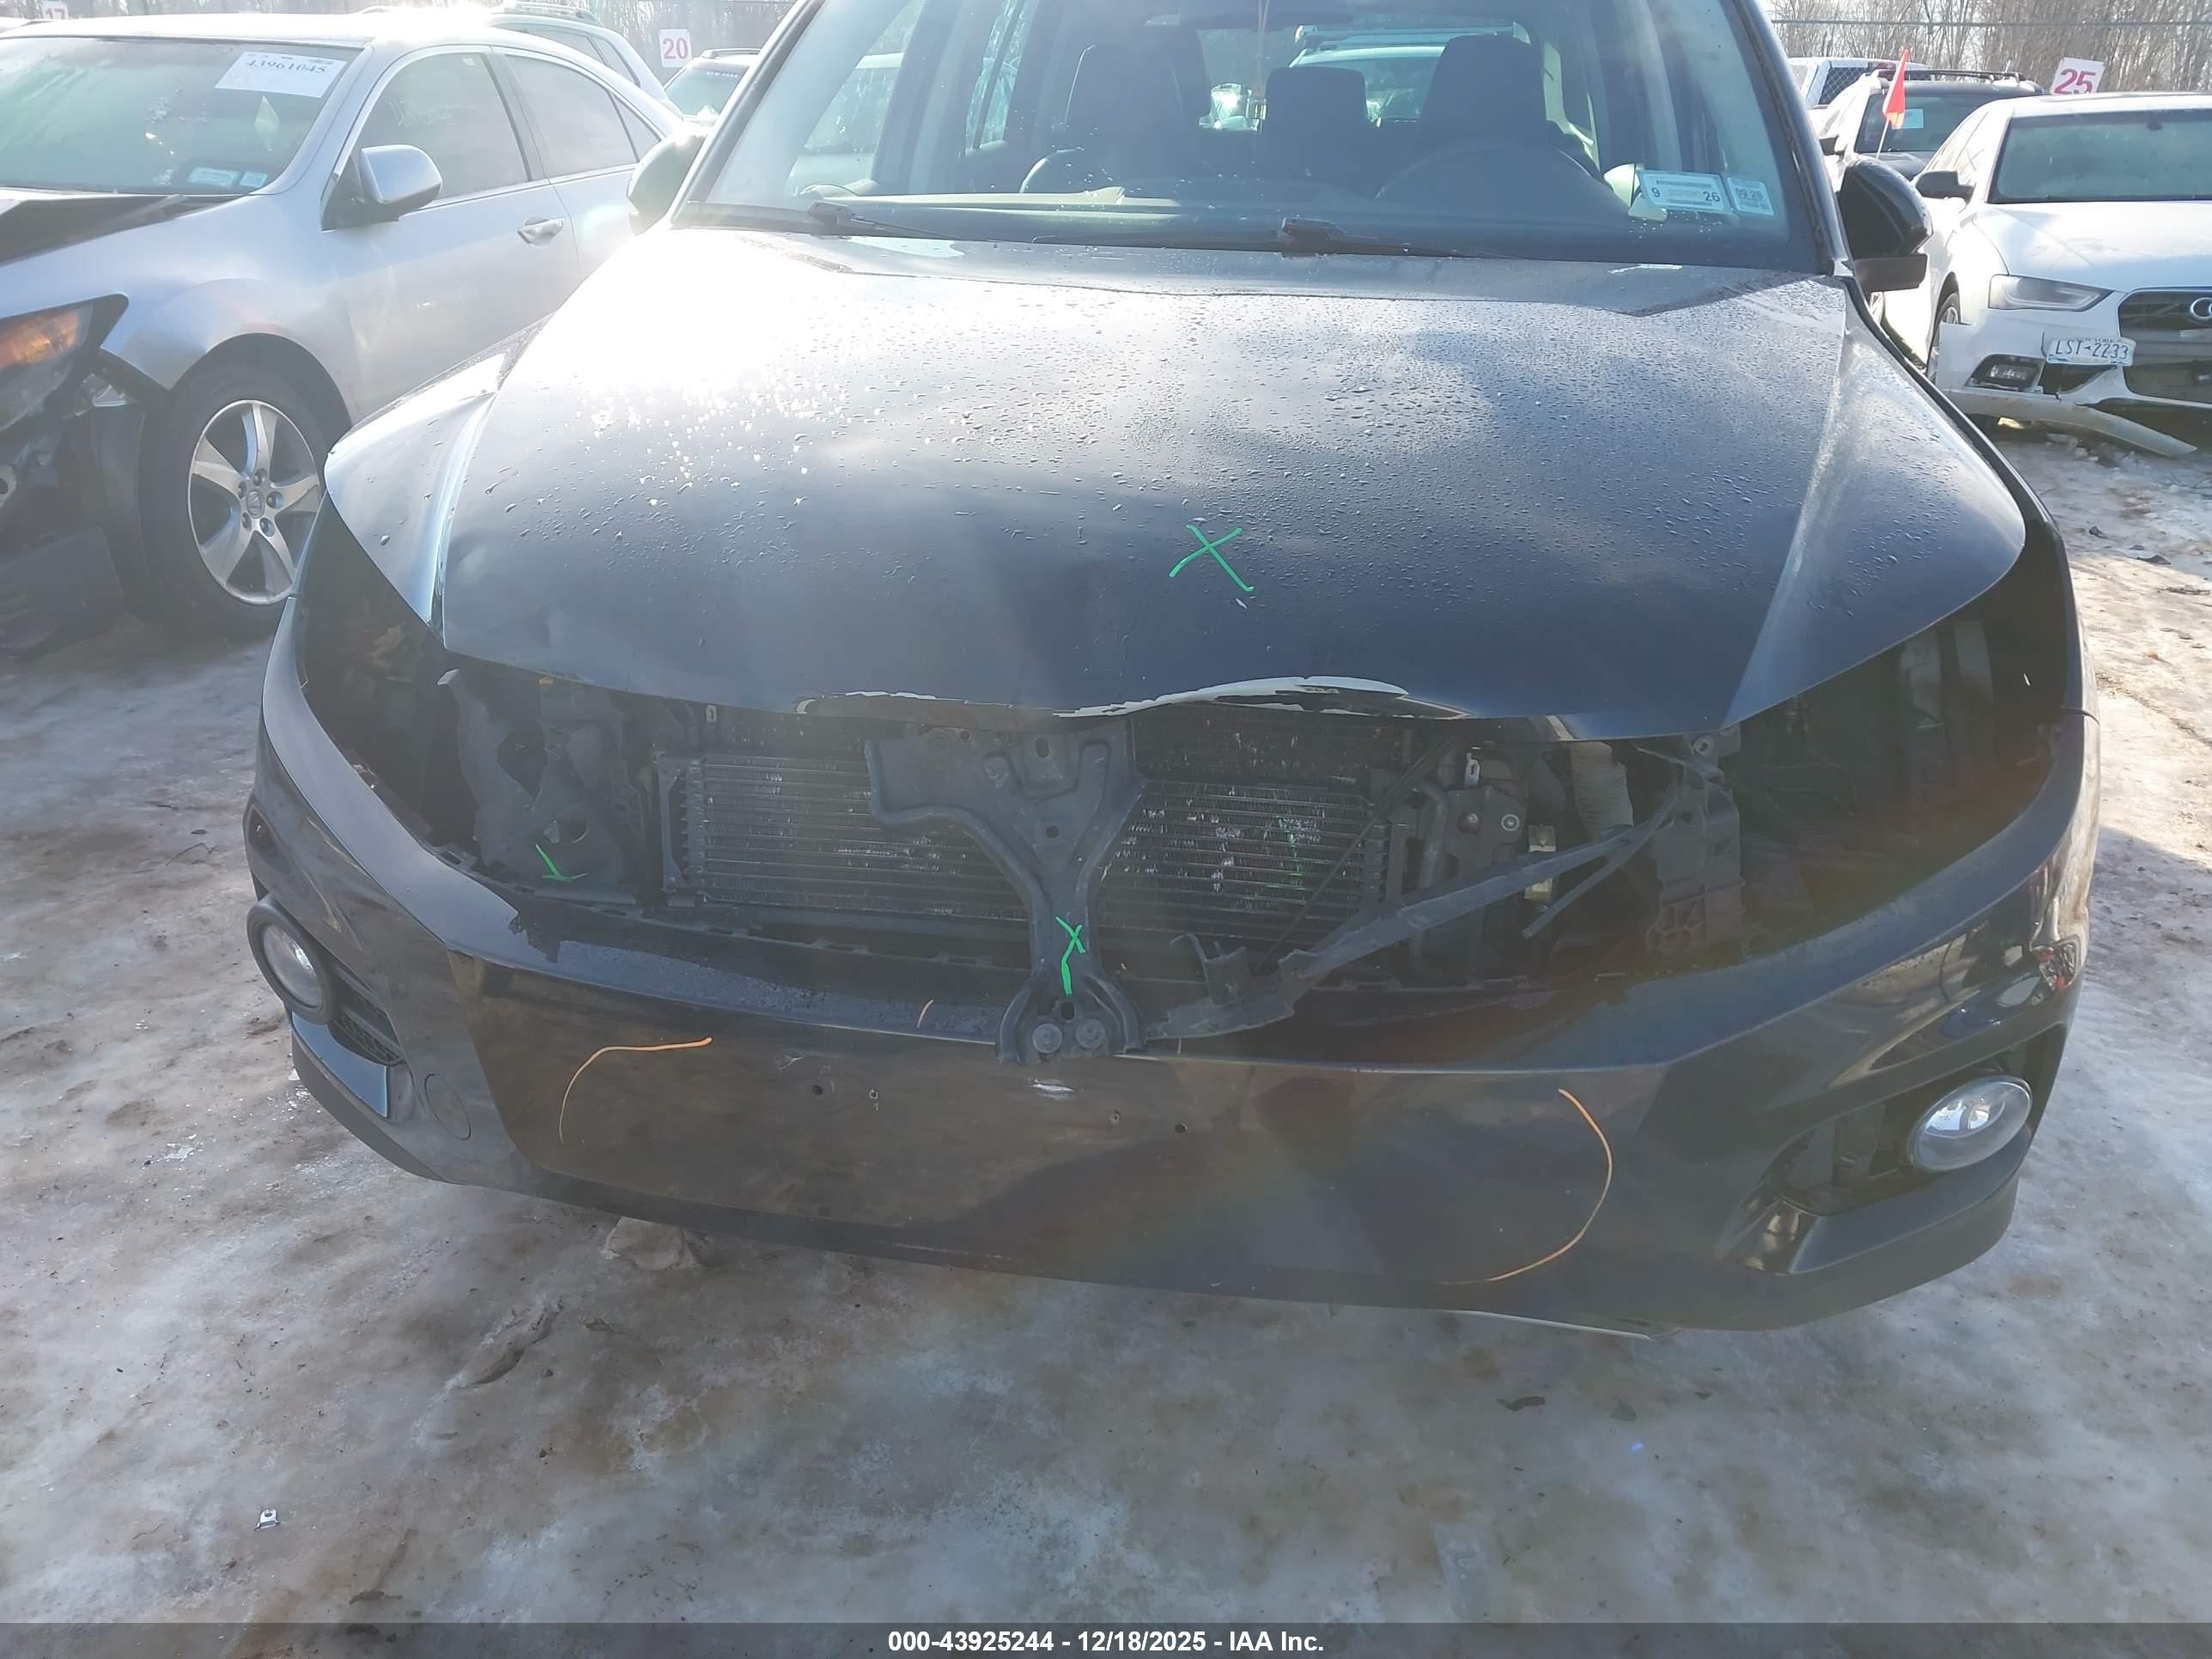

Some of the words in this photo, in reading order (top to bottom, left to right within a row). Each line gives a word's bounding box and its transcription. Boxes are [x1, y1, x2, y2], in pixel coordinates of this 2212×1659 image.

[663, 37, 689, 60] 20
[2054, 68, 2097, 94] 25
[1651, 186, 1661, 198] 9
[1703, 191, 1720, 203] 26
